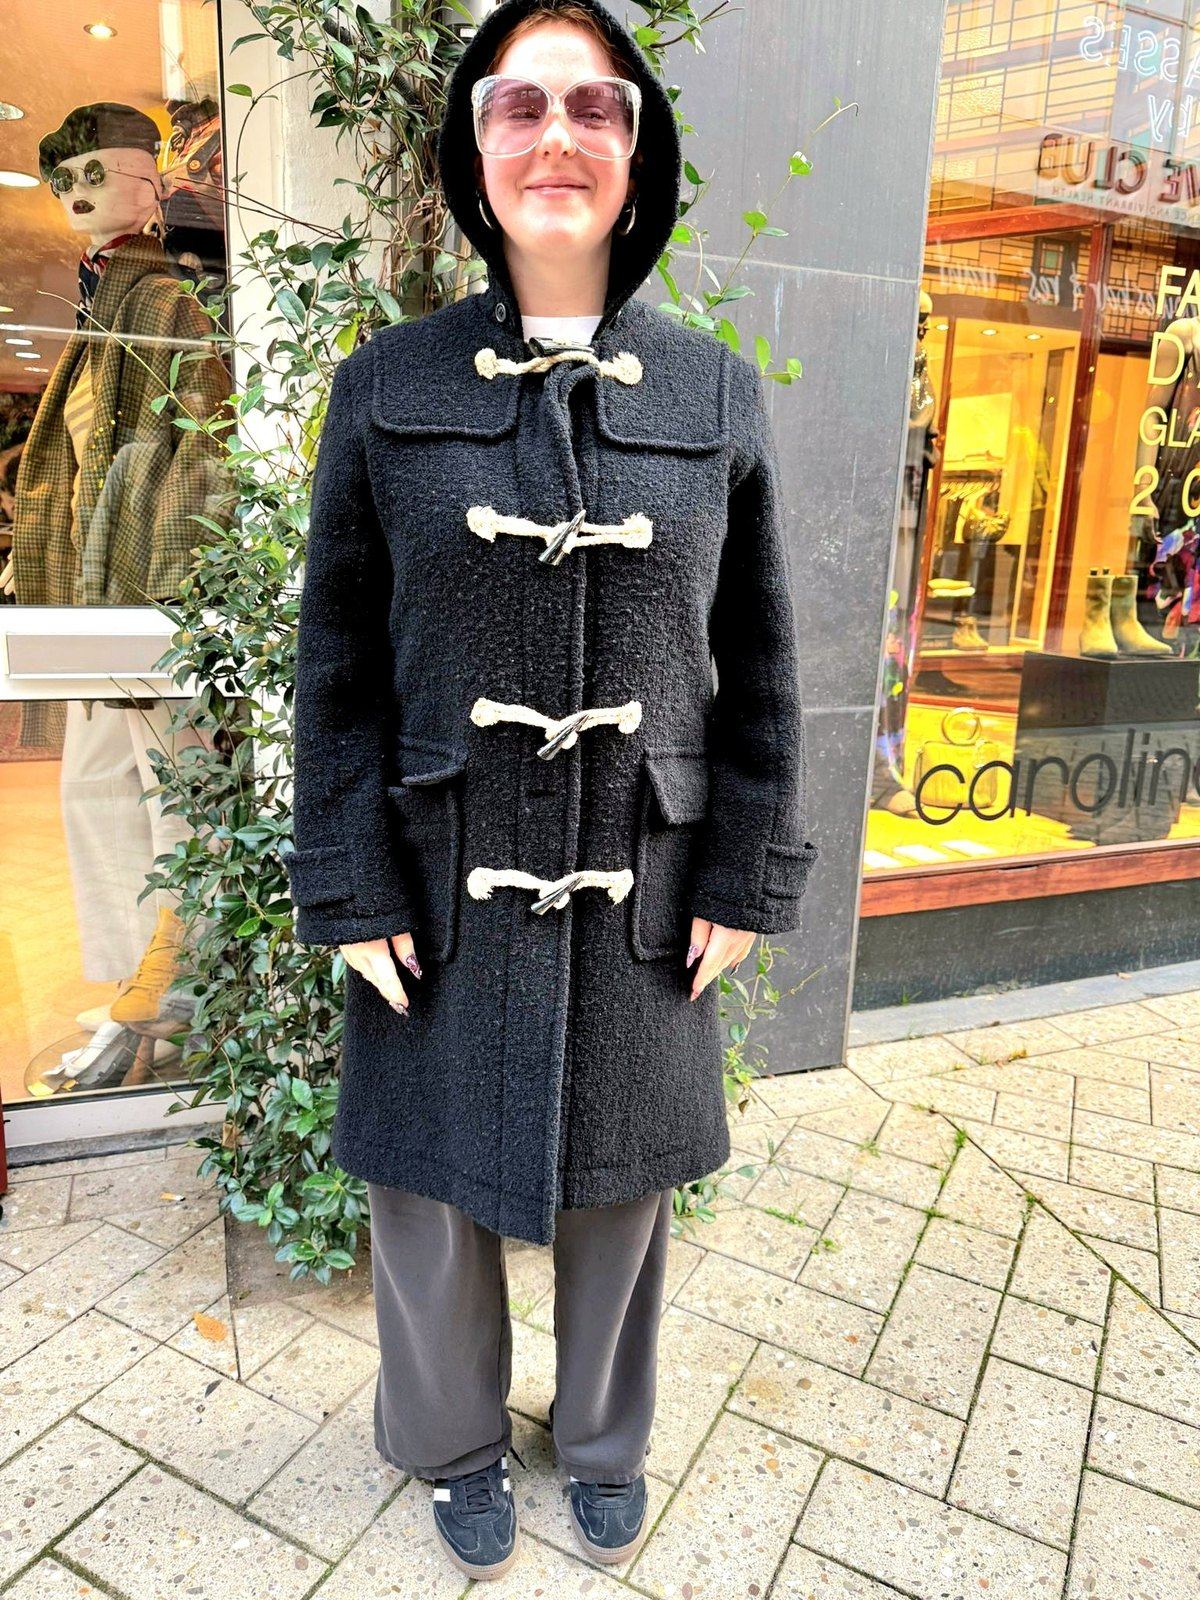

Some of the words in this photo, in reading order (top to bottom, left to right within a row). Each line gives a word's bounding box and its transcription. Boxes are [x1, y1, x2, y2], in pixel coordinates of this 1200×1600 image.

[1147, 332, 1200, 388] D
[1129, 465, 1159, 516] 2
[915, 728, 1200, 825] carolin
